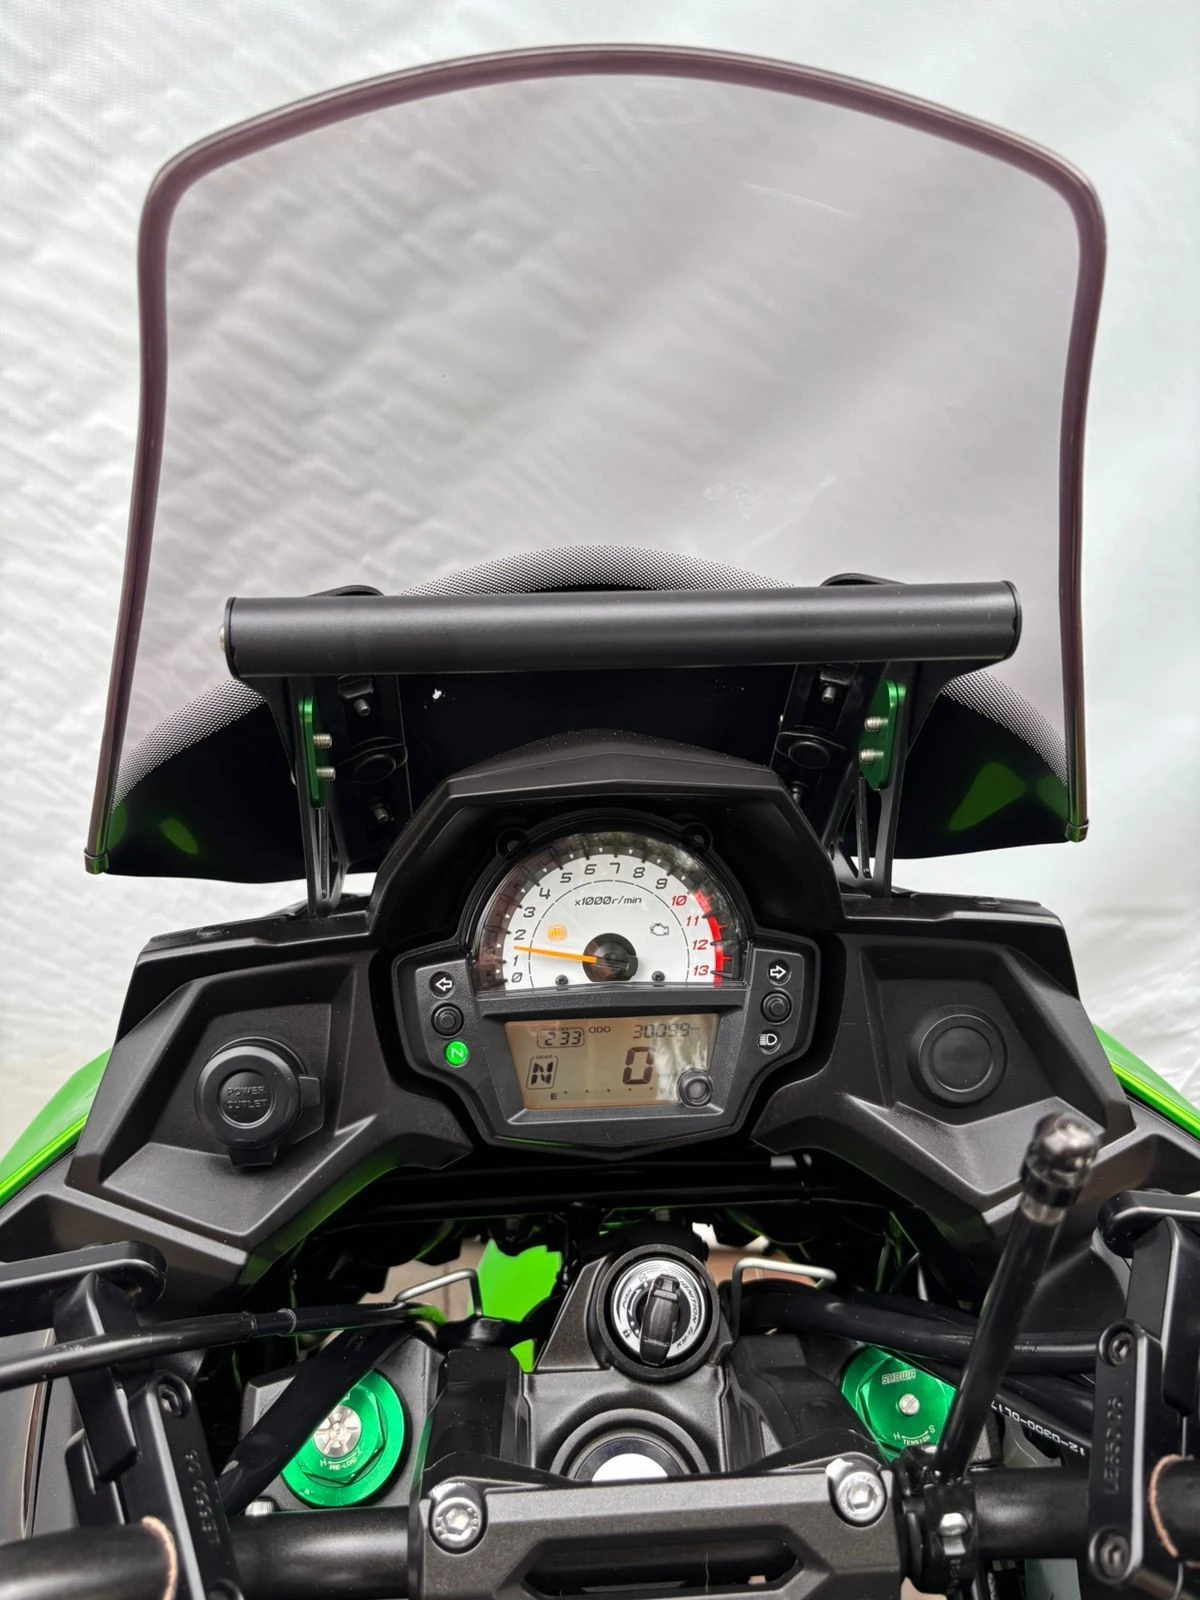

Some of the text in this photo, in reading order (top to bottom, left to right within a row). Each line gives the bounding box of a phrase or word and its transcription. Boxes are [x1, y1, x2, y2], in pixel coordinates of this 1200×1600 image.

[584, 863, 597, 875] 6
[609, 862, 621, 874] 7
[633, 867, 646, 879] 8
[560, 872, 573, 884] 5
[655, 878, 668, 890] 9
[539, 887, 551, 900] 4
[671, 895, 688, 907] 10
[523, 906, 536, 919] 3
[686, 916, 700, 927] 11
[514, 929, 527, 941] 2
[692, 939, 709, 951] 12
[512, 956, 520, 967] 1
[693, 965, 709, 976] 13
[511, 972, 523, 984] 0
[588, 1026, 612, 1034] ODO
[622, 1046, 655, 1085] 0
[530, 1061, 554, 1086] N
[227, 1085, 265, 1097] POWER
[550, 1092, 558, 1100] E
[226, 1098, 268, 1109] OUTLET
[680, 1280, 698, 1324] IGNITION
[881, 1368, 917, 1385] SHOWA
[893, 1424, 936, 1441] H S
[903, 1434, 931, 1446] TENSION
